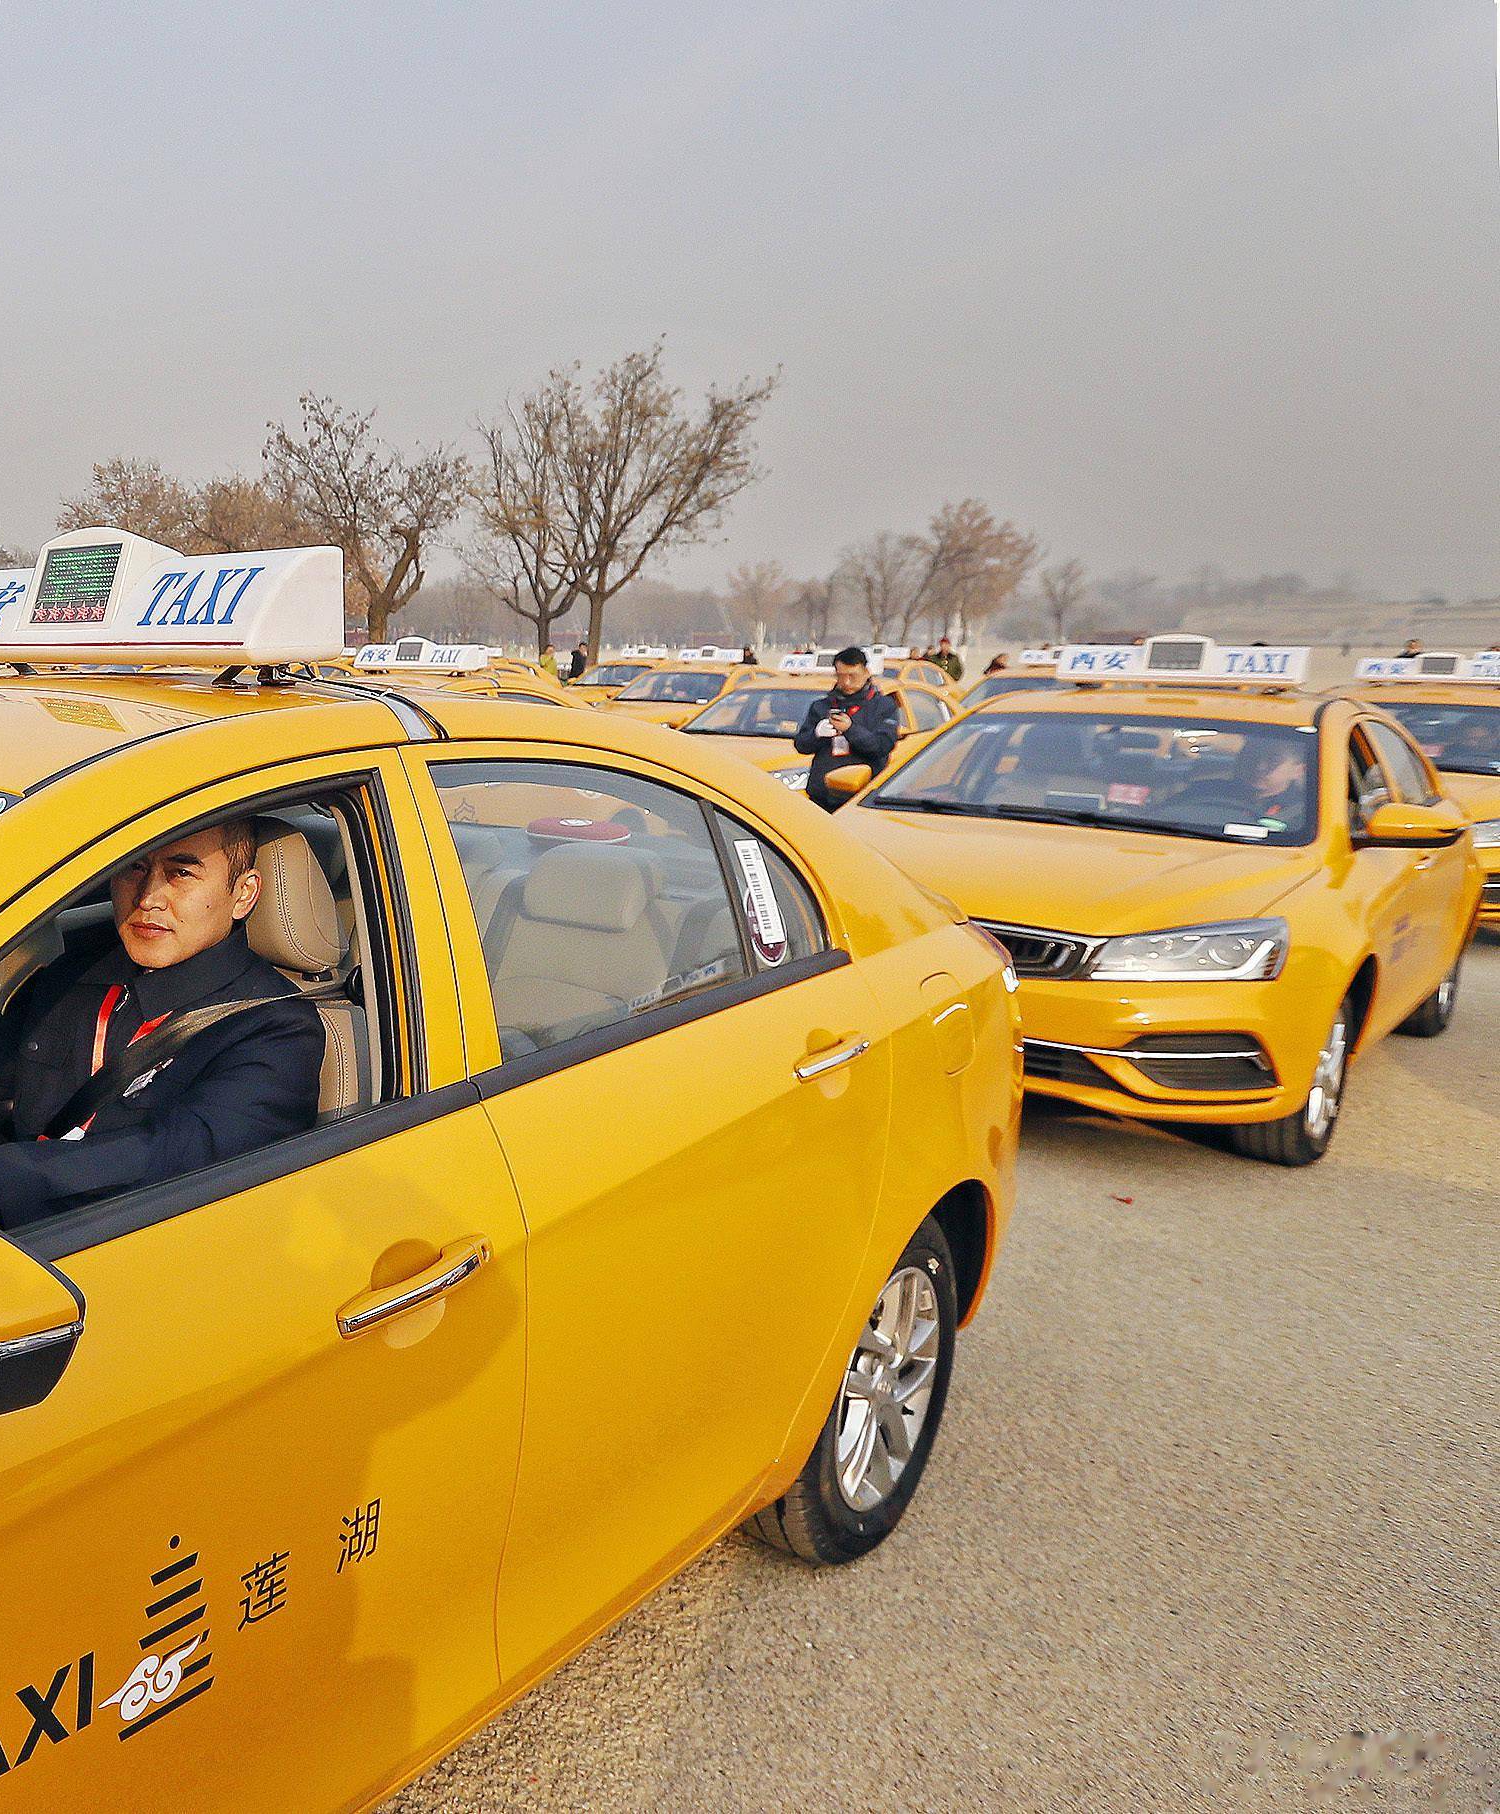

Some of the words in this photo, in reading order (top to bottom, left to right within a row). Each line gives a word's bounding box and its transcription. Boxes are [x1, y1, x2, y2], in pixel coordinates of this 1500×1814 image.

[137, 567, 265, 626] TAXI
[430, 649, 461, 663] TAXI
[1070, 651, 1132, 670] 西安
[1226, 653, 1290, 674] TAXI
